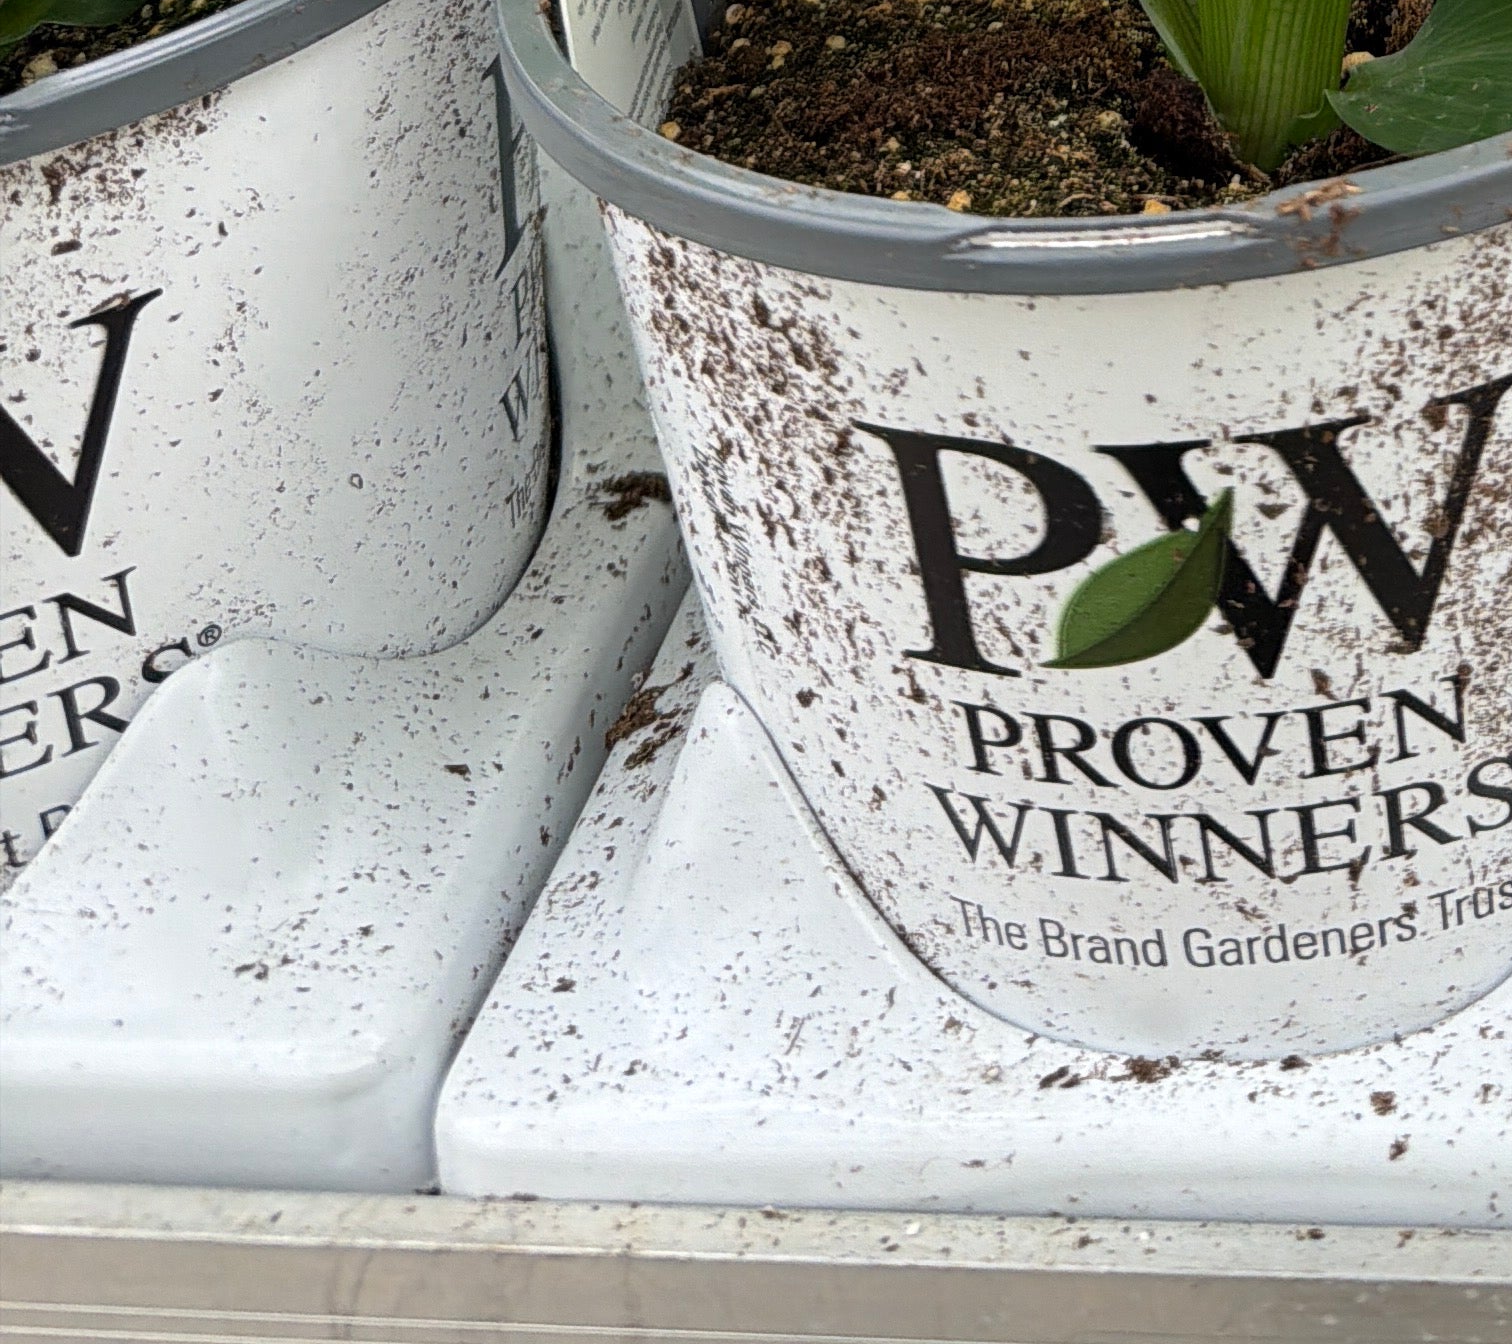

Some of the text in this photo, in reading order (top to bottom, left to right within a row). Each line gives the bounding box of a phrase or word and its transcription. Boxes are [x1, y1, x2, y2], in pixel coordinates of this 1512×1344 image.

[950, 674, 1469, 791] PROVEN
[950, 895, 1029, 952] The
[1037, 917, 1168, 969] Brand
